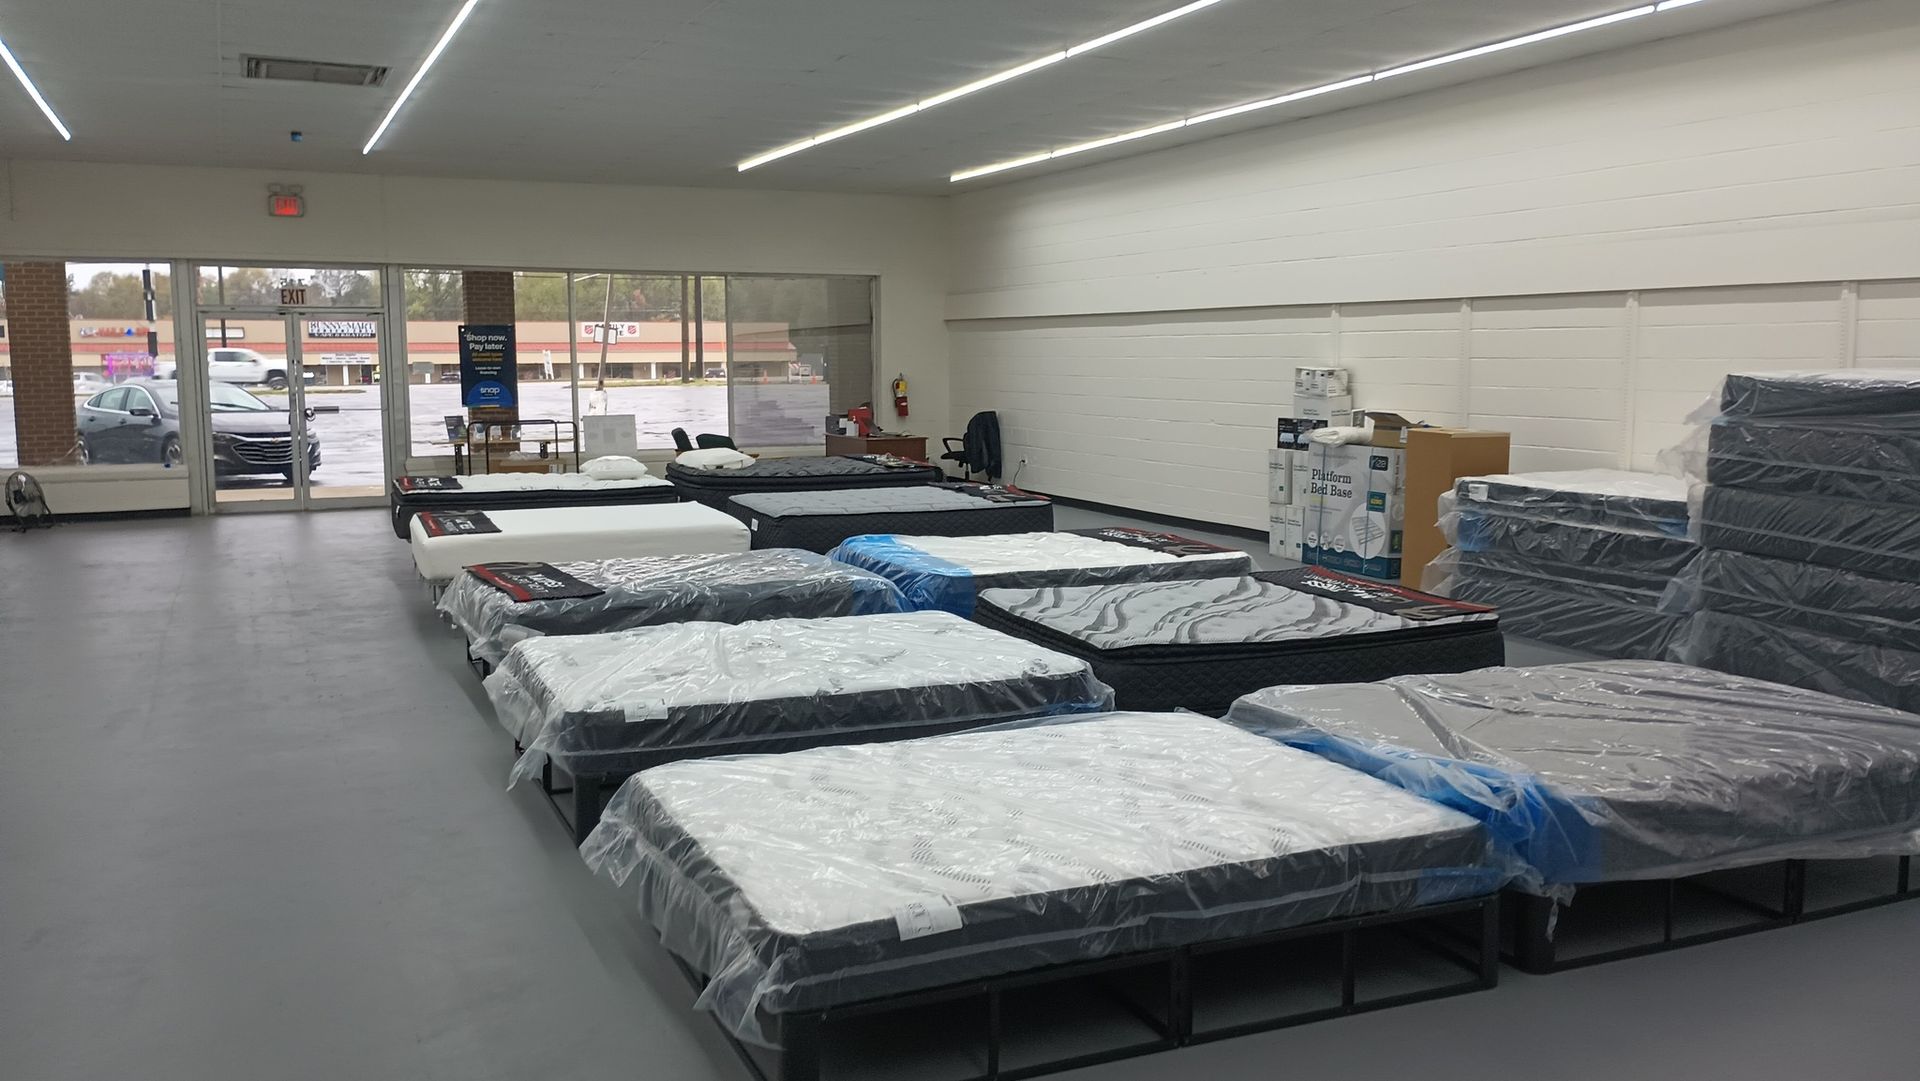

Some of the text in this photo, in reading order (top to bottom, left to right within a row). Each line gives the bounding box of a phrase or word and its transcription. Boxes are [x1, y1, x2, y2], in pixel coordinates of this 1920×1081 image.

[281, 289, 306, 305] EXIT
[466, 334, 487, 342] Shop
[469, 343, 484, 351] Pay
[480, 387, 500, 395] snap
[1311, 469, 1352, 484] Platform
[1311, 482, 1353, 499] Bed Base
